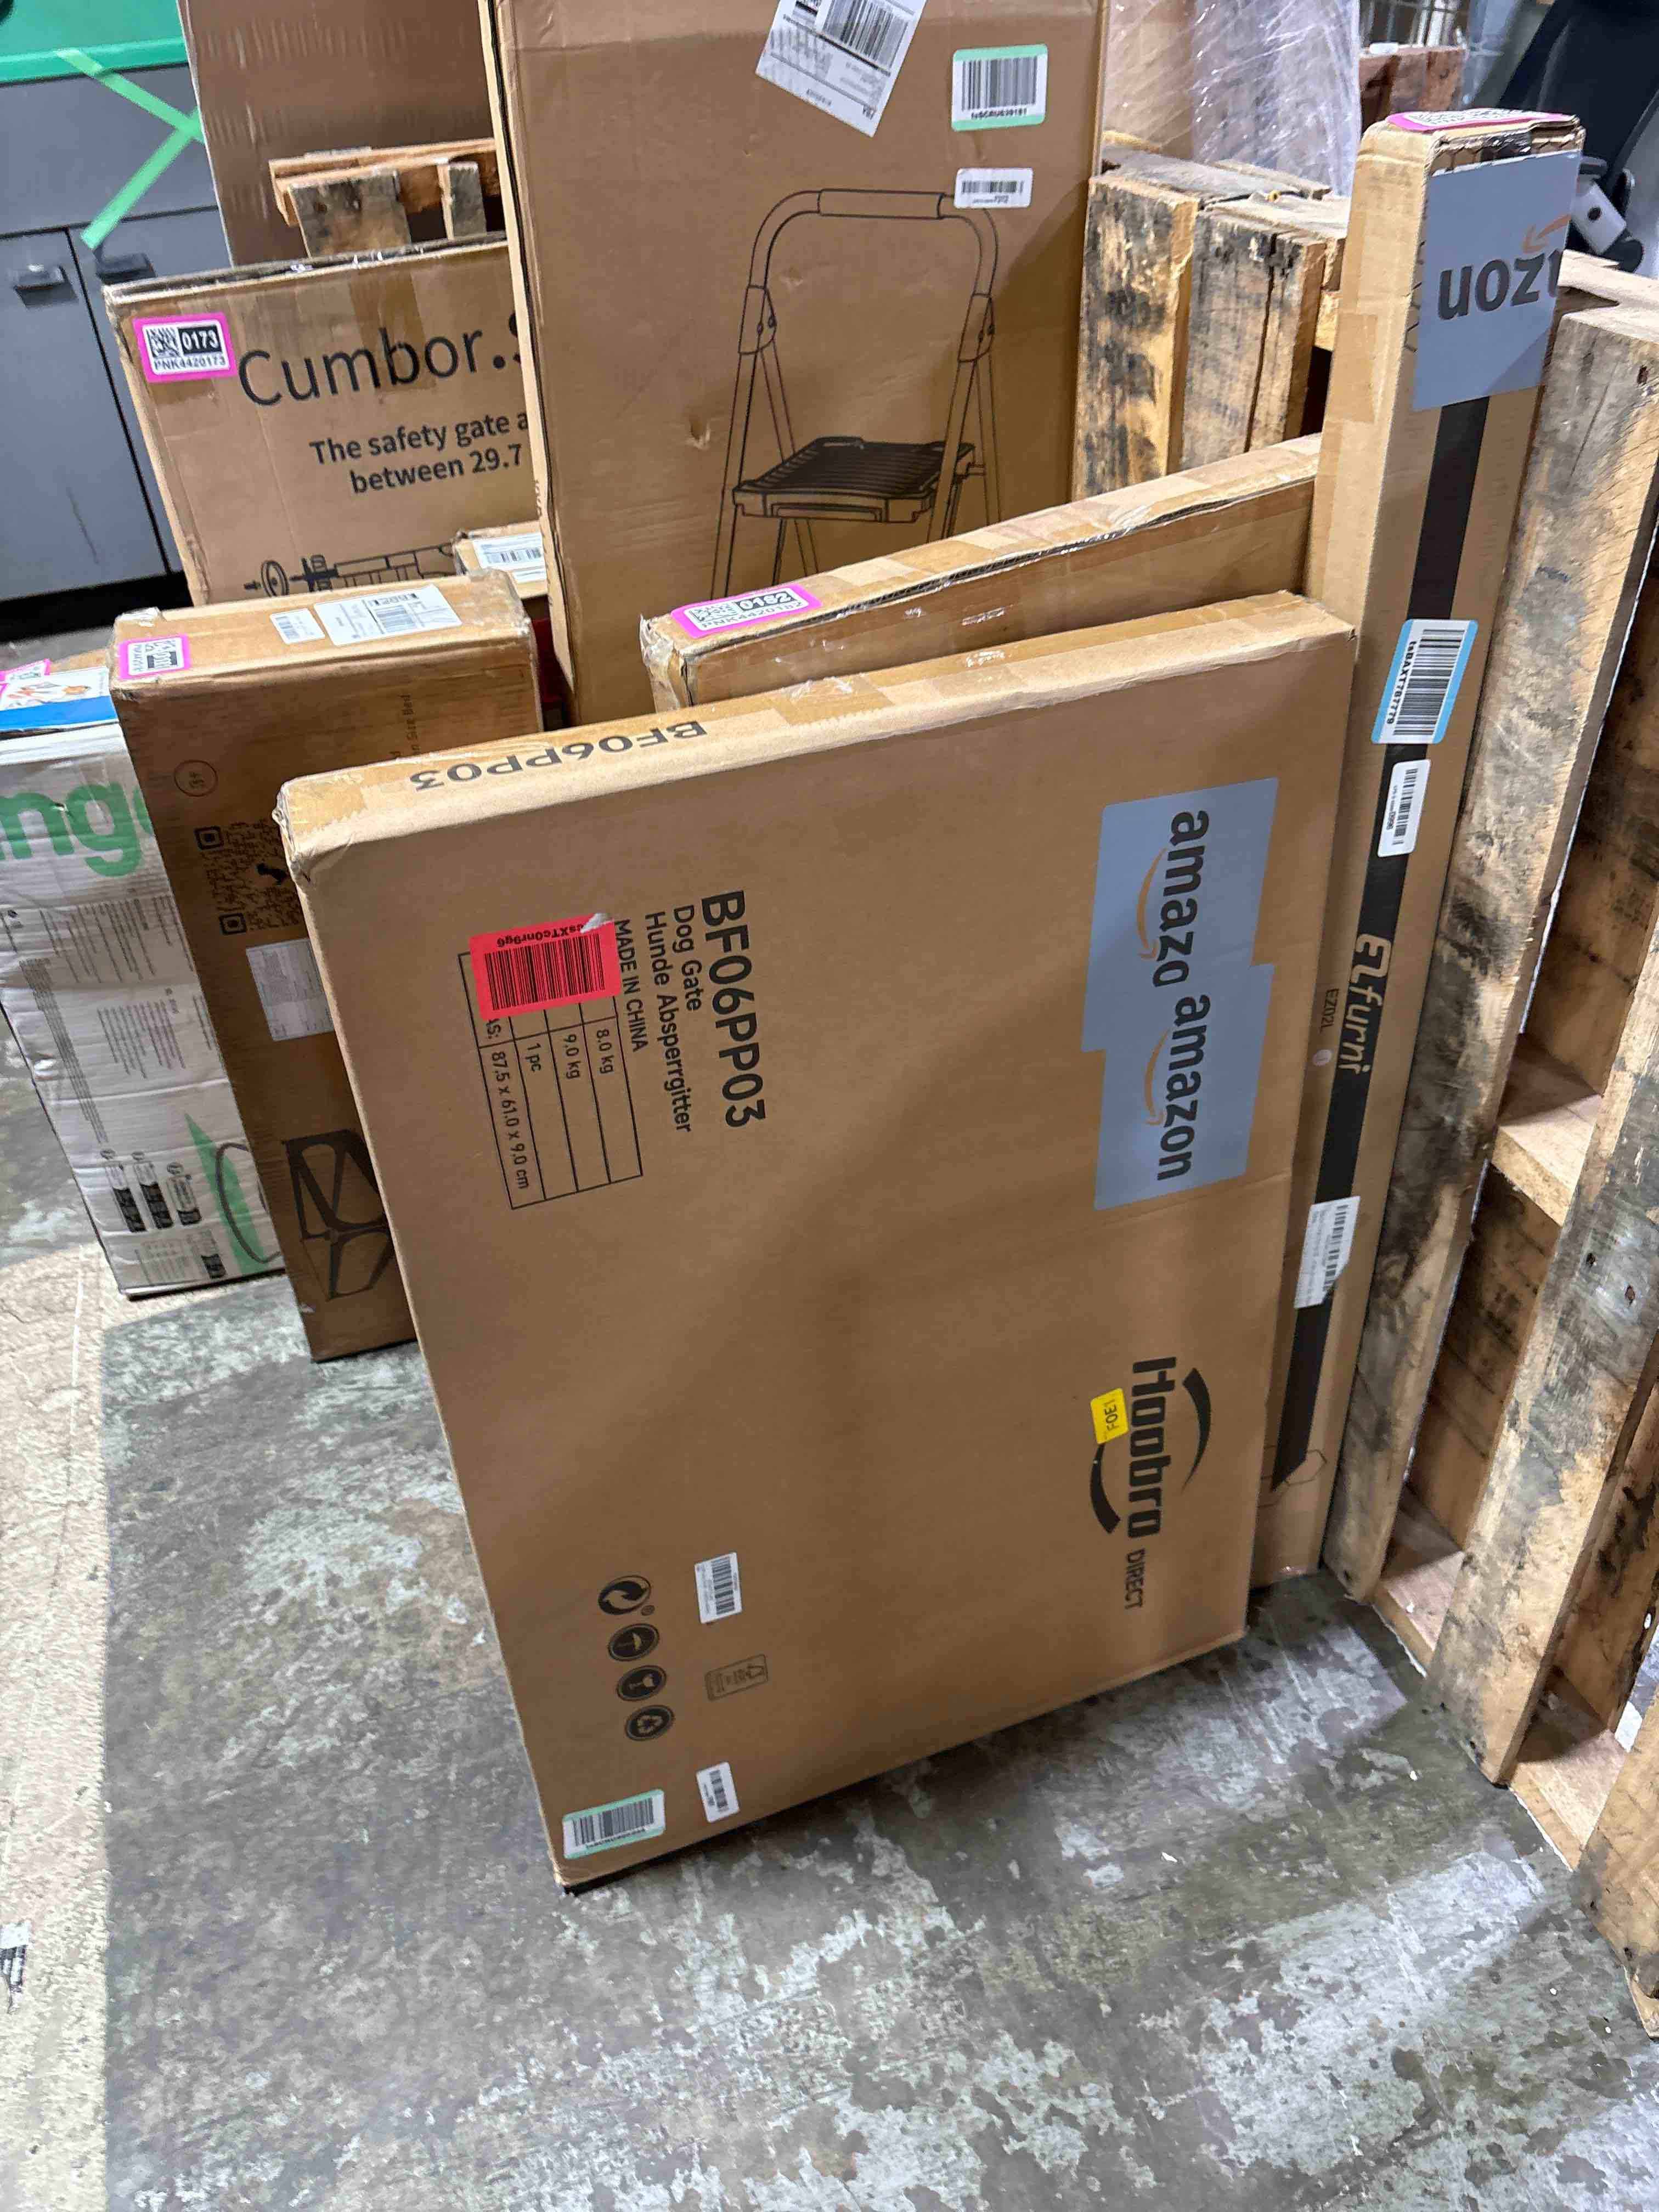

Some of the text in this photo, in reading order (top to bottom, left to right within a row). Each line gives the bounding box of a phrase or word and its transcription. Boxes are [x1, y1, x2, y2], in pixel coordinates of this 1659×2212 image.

[154, 353, 227, 370] PNK4420173
[181, 329, 219, 351] 0173
[239, 312, 521, 406] Cumbor.
[309, 438, 362, 464] The
[369, 424, 447, 457] safety
[455, 414, 512, 448] gate
[350, 443, 522, 493] between 29.7
[740, 592, 792, 610] 0182
[409, 720, 708, 792] BF06PP03
[615, 918, 648, 1053] MADE IN CHINA
[674, 905, 703, 1012] Dog Gate
[645, 911, 691, 1133] Hunde Absperrgitter
[702, 890, 766, 1128] BF06PP03
[526, 1043, 541, 1073] 1 pc
[564, 1034, 580, 1080] 9.0 kg
[595, 1029, 615, 1075] 8.0 kg
[1156, 994, 1211, 1181] amazon
[492, 1051, 529, 1190] 87.5 x 61.0 x 9.0 cm
[1125, 1356, 1177, 1610] Hoobro DIRECT
